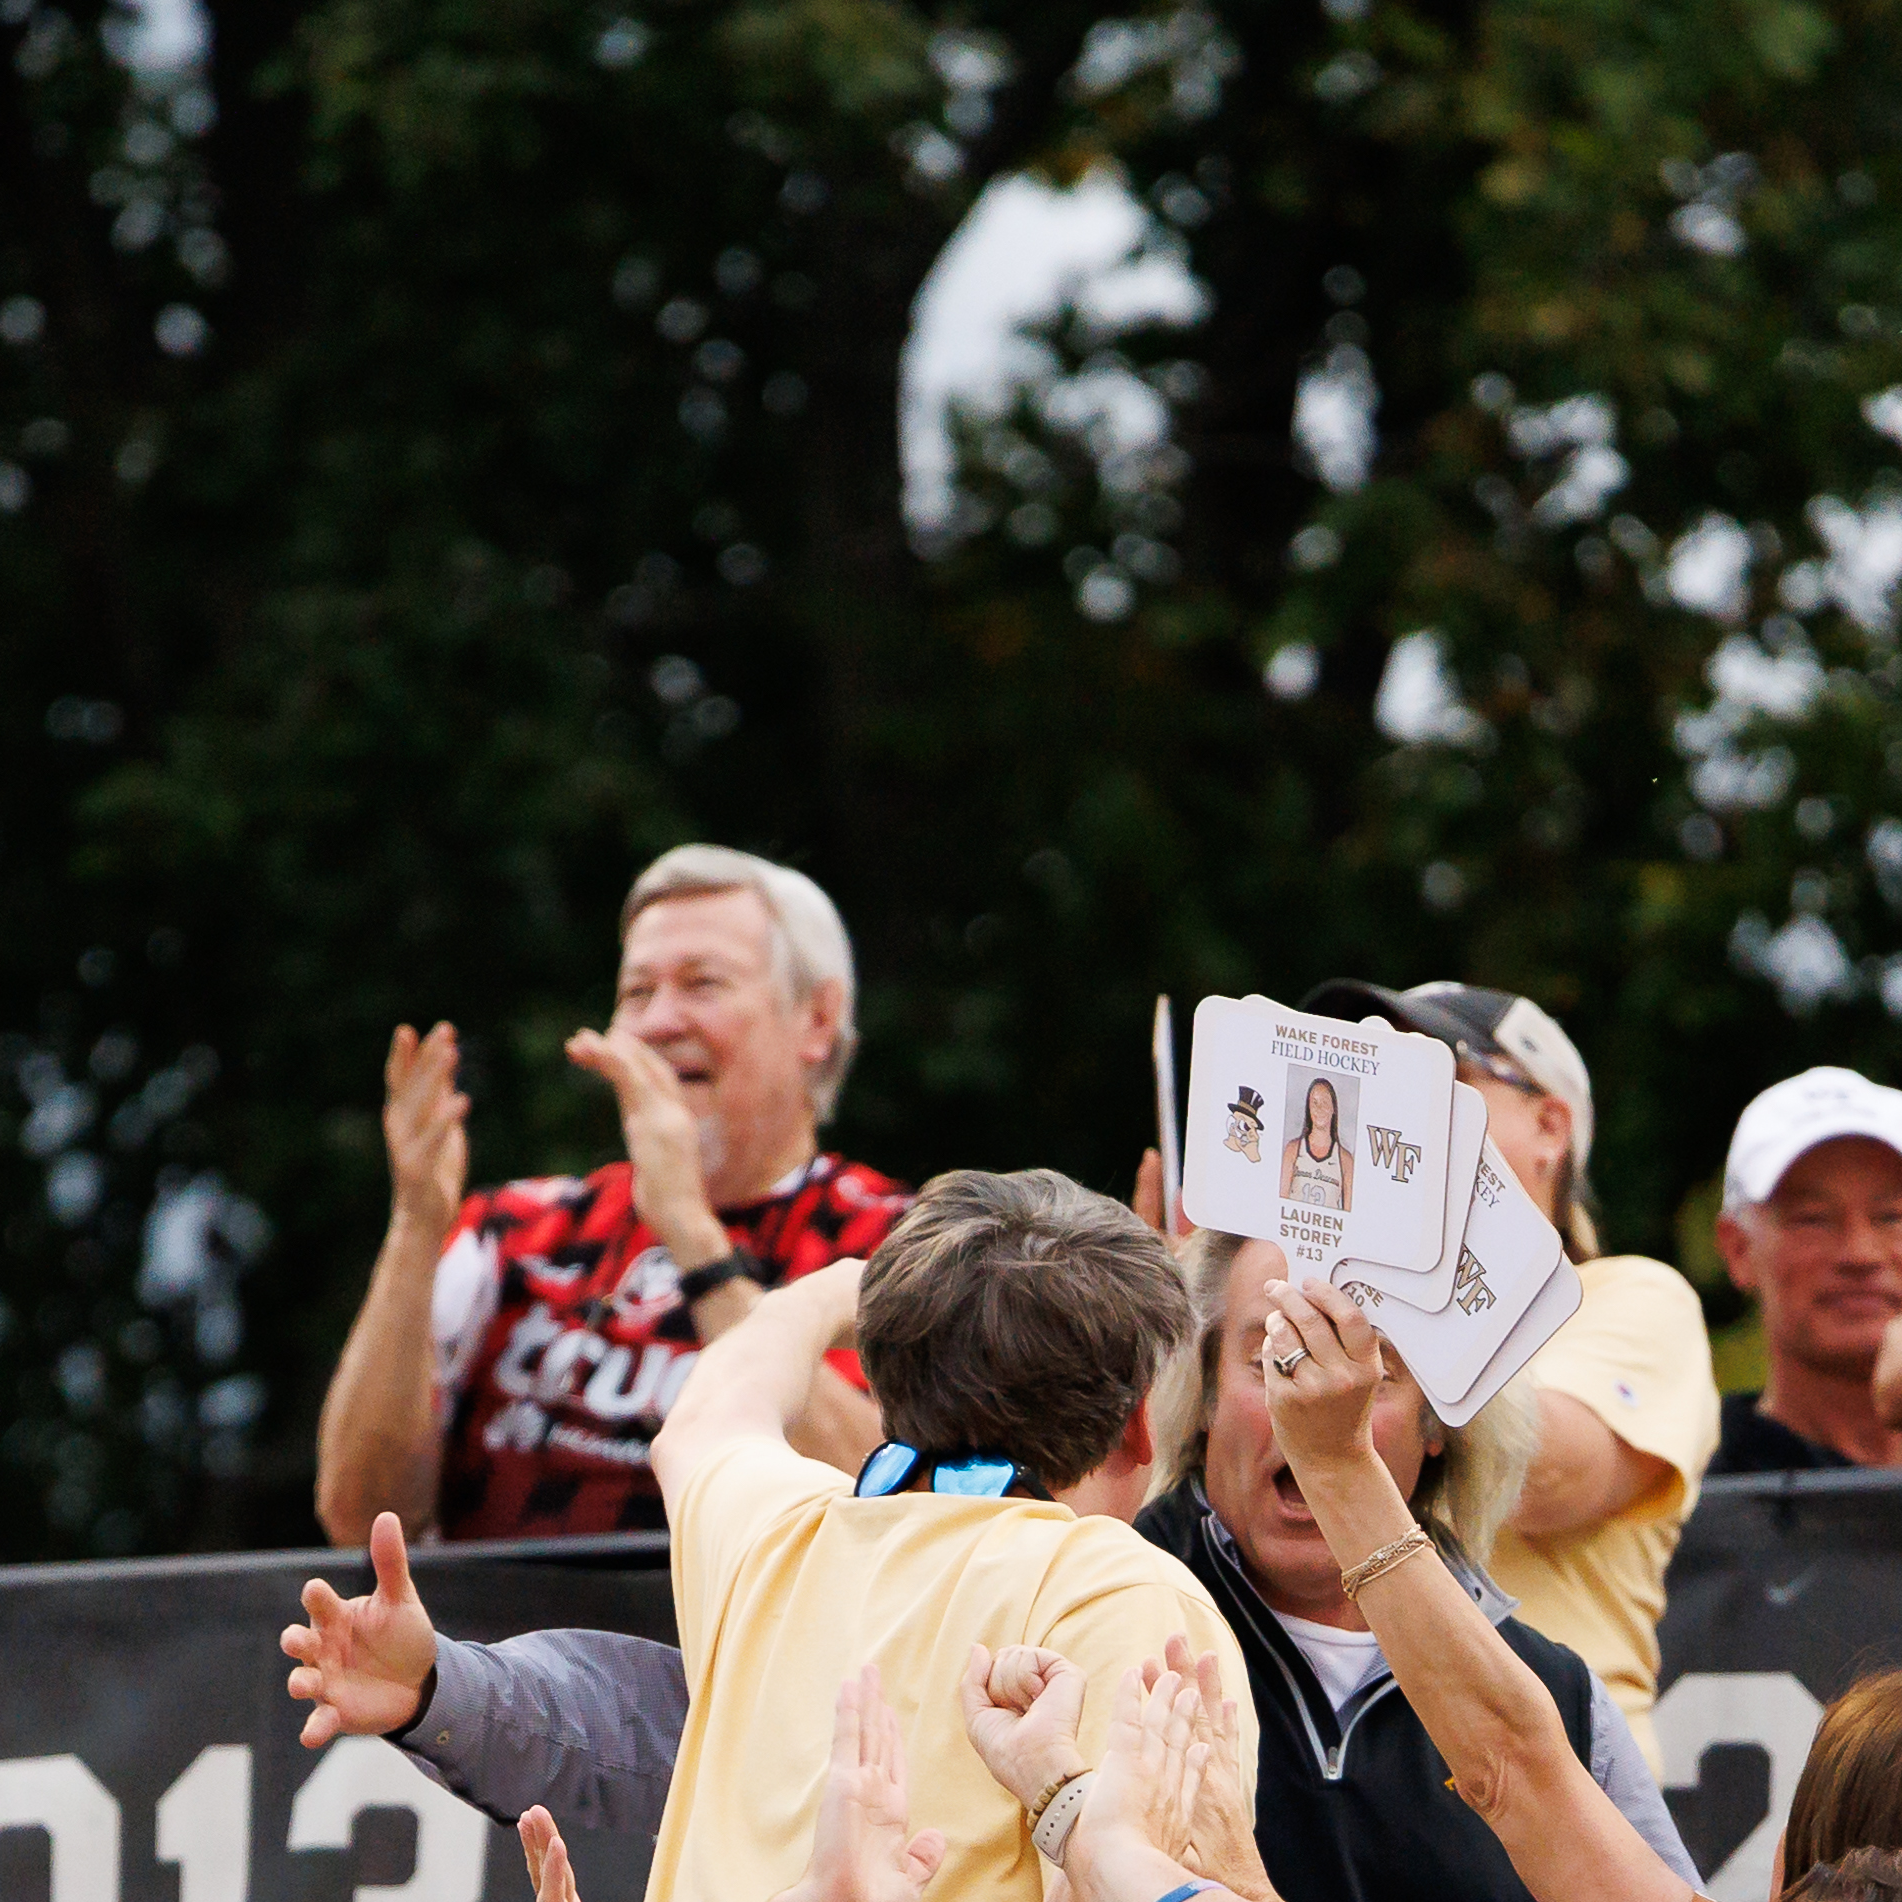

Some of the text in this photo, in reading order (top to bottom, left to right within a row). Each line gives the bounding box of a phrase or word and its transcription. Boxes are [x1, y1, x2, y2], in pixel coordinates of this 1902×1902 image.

[1275, 1024, 1378, 1057] WAKE FOREST
[1271, 1040, 1380, 1076] FIELD HOCKEY
[1366, 1125, 1422, 1184] WF
[1281, 1206, 1343, 1231] LAUREN
[1280, 1224, 1342, 1247] STOREY
[1296, 1245, 1323, 1262] #13
